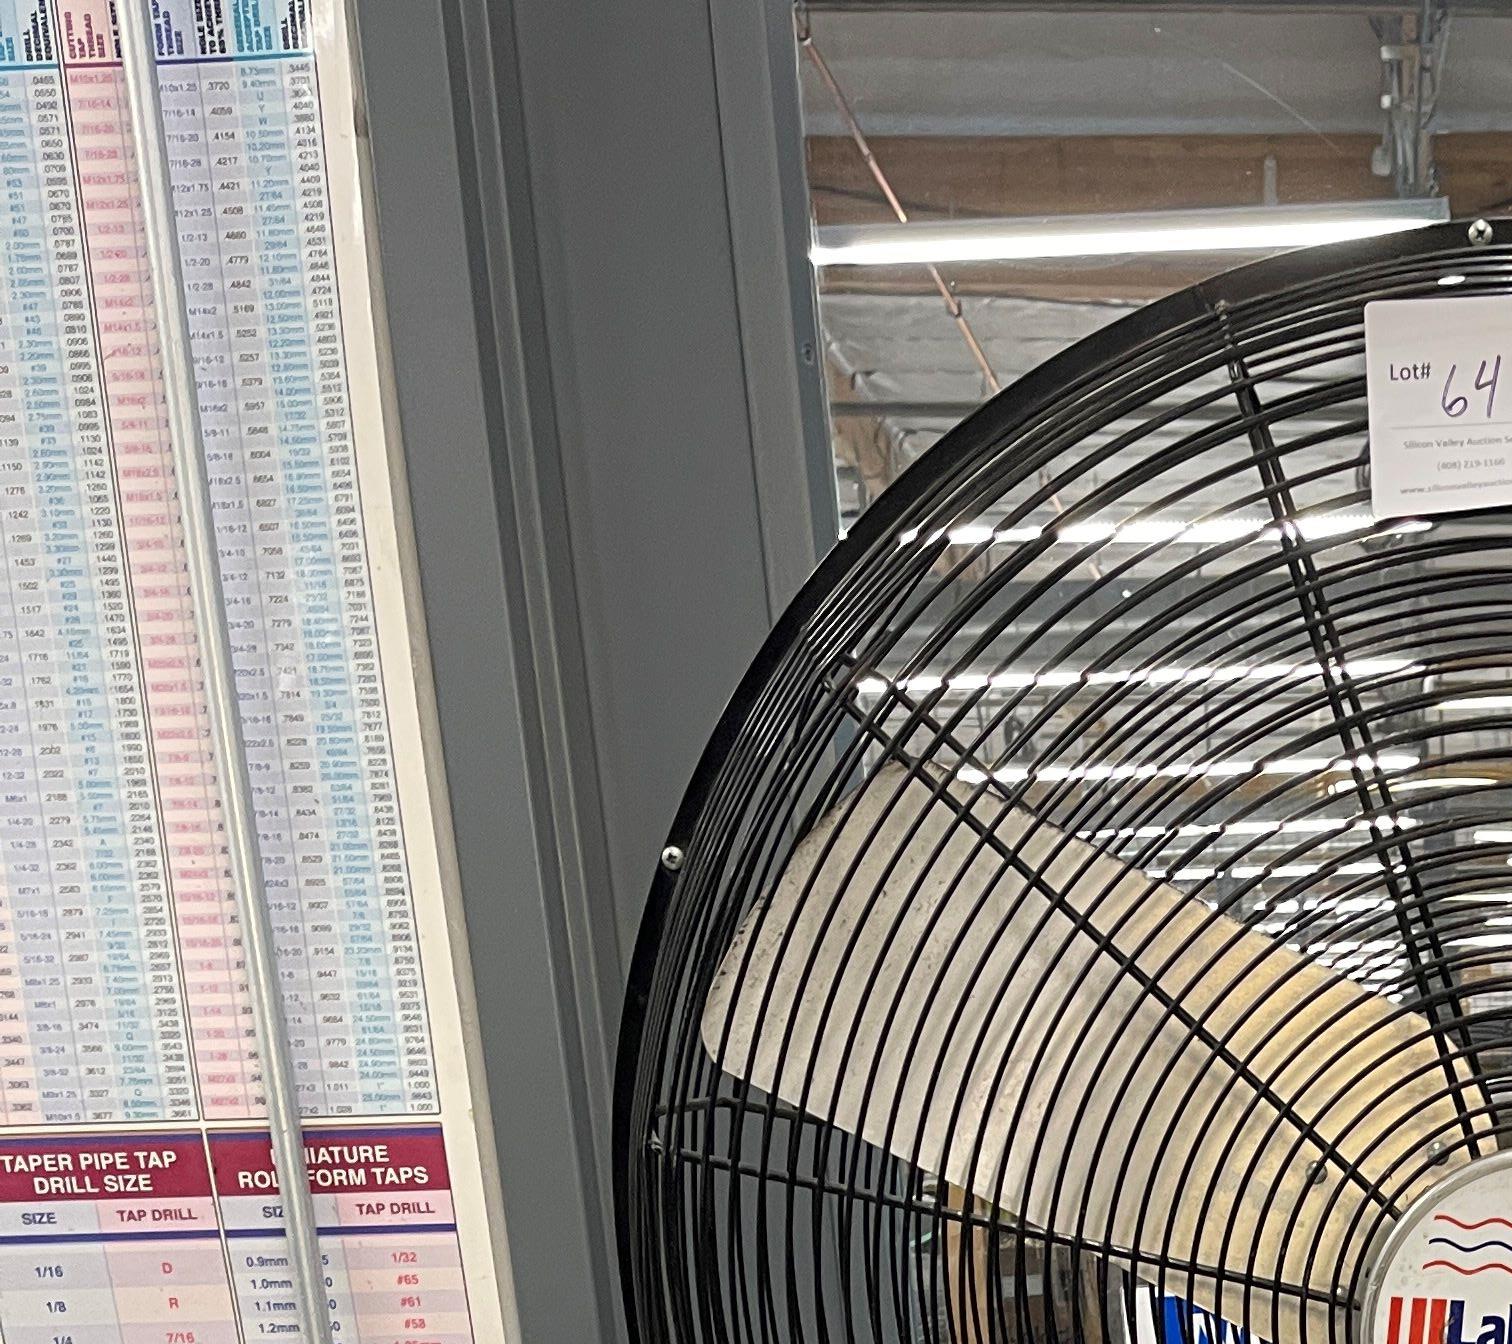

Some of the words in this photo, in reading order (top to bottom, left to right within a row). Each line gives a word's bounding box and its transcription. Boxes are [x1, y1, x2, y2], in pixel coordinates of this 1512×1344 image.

[1390, 362, 1431, 381] Lot#
[1441, 354, 1501, 418] 64
[1, 1155, 73, 1174] TAPER
[79, 1152, 130, 1171] PIPE
[134, 1150, 177, 1169] TAP
[238, 1170, 279, 1188] ROL
[371, 1166, 429, 1184] TAPS
[33, 1176, 99, 1195] DRILL
[104, 1174, 153, 1193] SIZE
[116, 1209, 147, 1222] TAP
[152, 1208, 198, 1222] DRILL
[263, 1206, 284, 1218] SIZ
[355, 1203, 385, 1216] TAP
[390, 1202, 436, 1215] DRILL
[21, 1212, 57, 1225] SIZE
[246, 1256, 288, 1268] 0.9mm
[392, 1251, 417, 1263] 1/32
[35, 1265, 64, 1278] 1/16
[162, 1262, 173, 1275] D
[250, 1279, 293, 1289] 1.0mm
[46, 1301, 67, 1313] 1/8
[169, 1297, 179, 1309] R
[255, 1301, 296, 1311] 1.1mm
[259, 1323, 300, 1333] 1.2mm
[166, 1332, 195, 1344] 7/16
